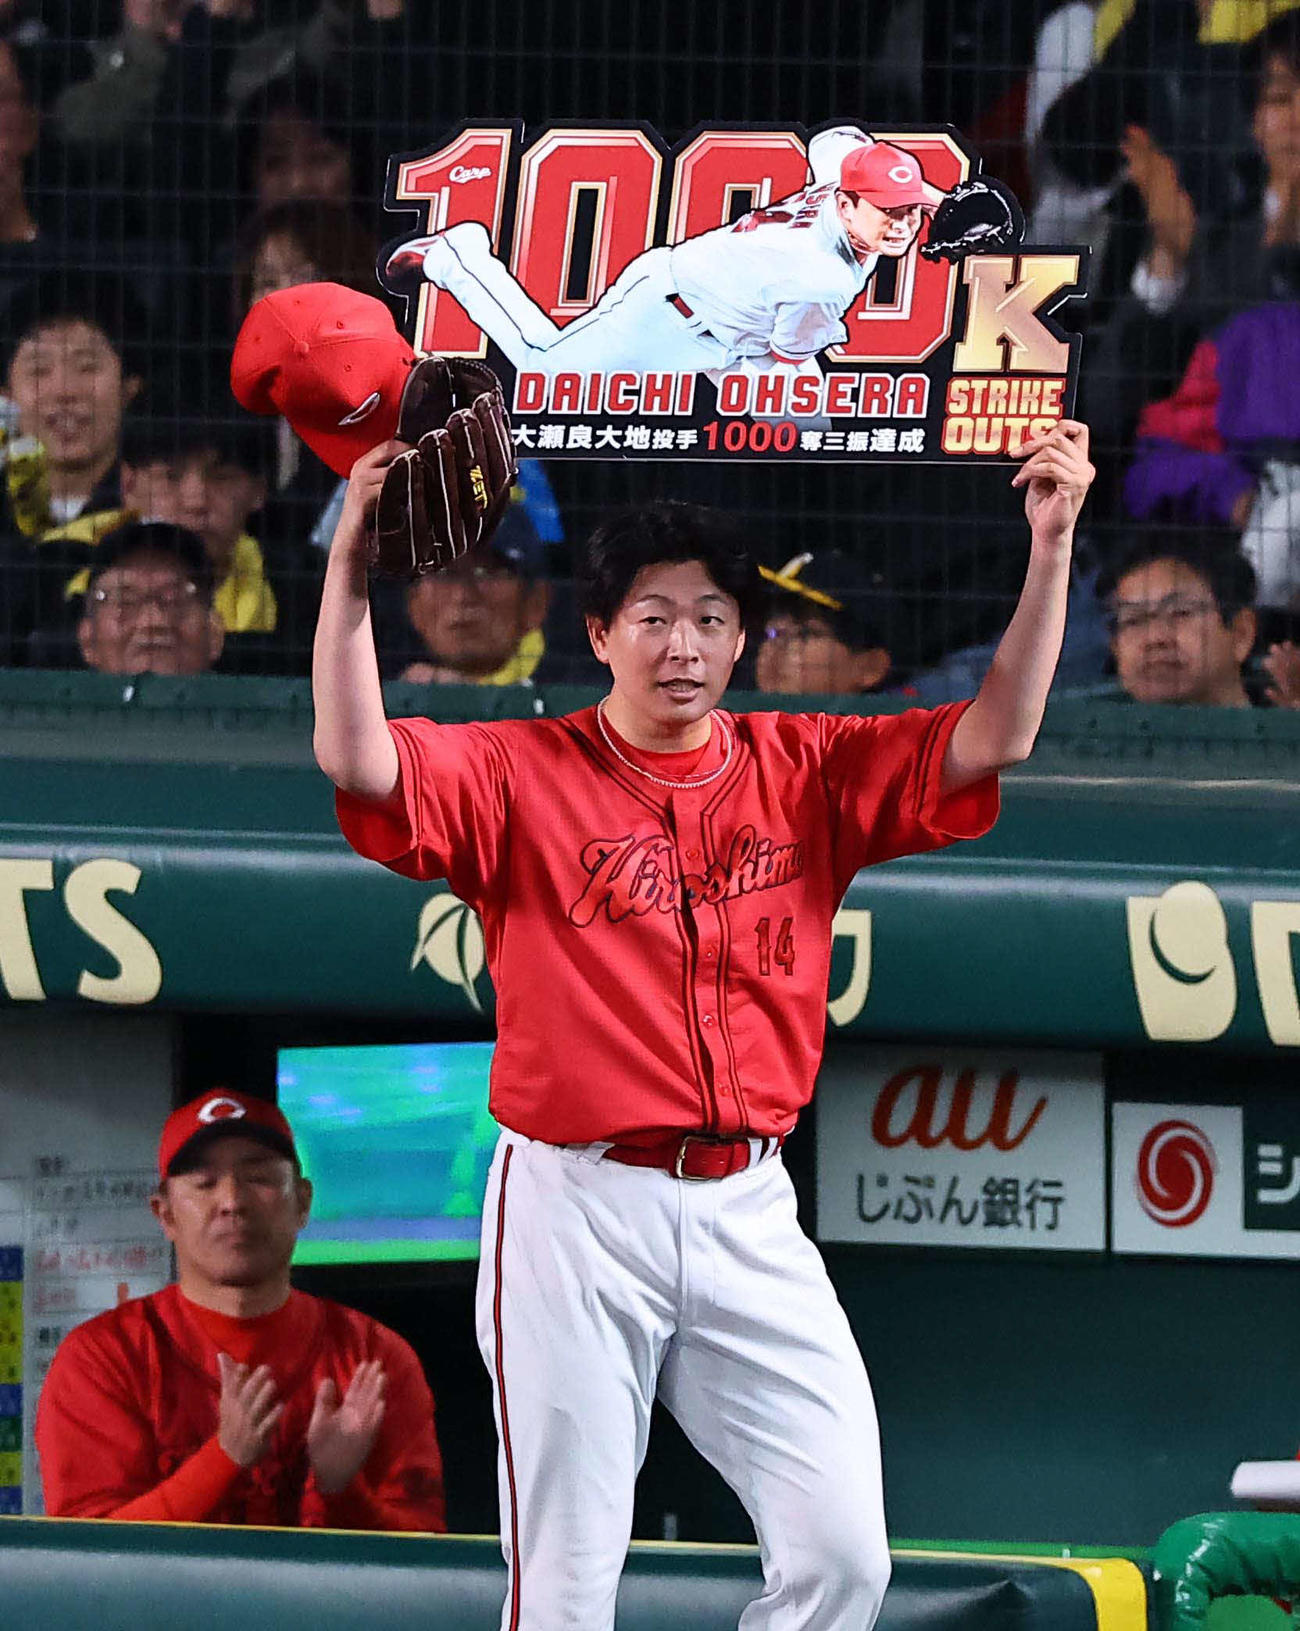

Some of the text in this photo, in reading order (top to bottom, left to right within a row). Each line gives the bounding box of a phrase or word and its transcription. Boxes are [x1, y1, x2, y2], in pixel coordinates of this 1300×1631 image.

[449, 165, 492, 184] Carp
[952, 254, 1080, 373] K
[512, 370, 931, 418] DAICHI OHSERA
[946, 376, 1067, 418] STRIKE
[755, 917, 795, 976] 14
[872, 1065, 1048, 1152] au
[857, 1173, 1064, 1231] じぶん銀行
